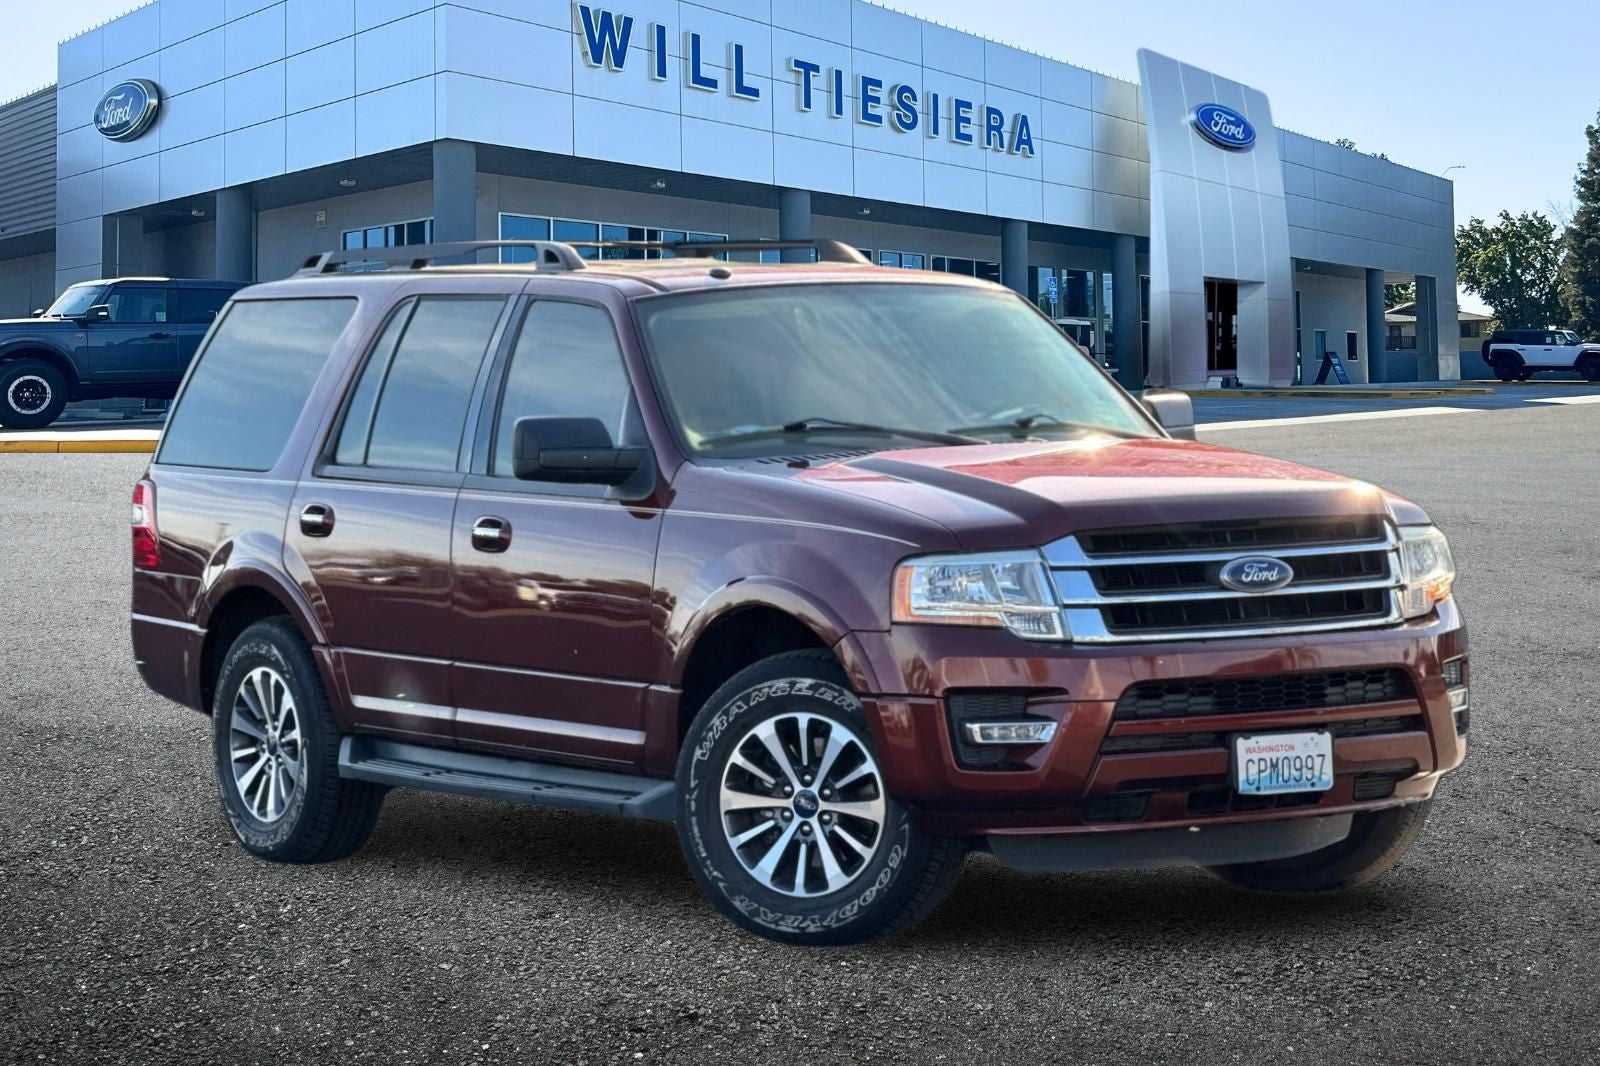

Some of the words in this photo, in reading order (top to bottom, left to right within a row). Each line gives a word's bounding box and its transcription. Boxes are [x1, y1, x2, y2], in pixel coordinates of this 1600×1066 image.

[577, 3, 761, 100] WILL
[788, 57, 1036, 157] TIESIERA
[101, 92, 133, 129] Ford
[1210, 110, 1245, 140] Ford
[1241, 563, 1279, 583] Ford
[697, 681, 859, 761] WRANGLER
[1245, 743, 1296, 755] WASHINGTON
[1245, 753, 1326, 787] CPM0997
